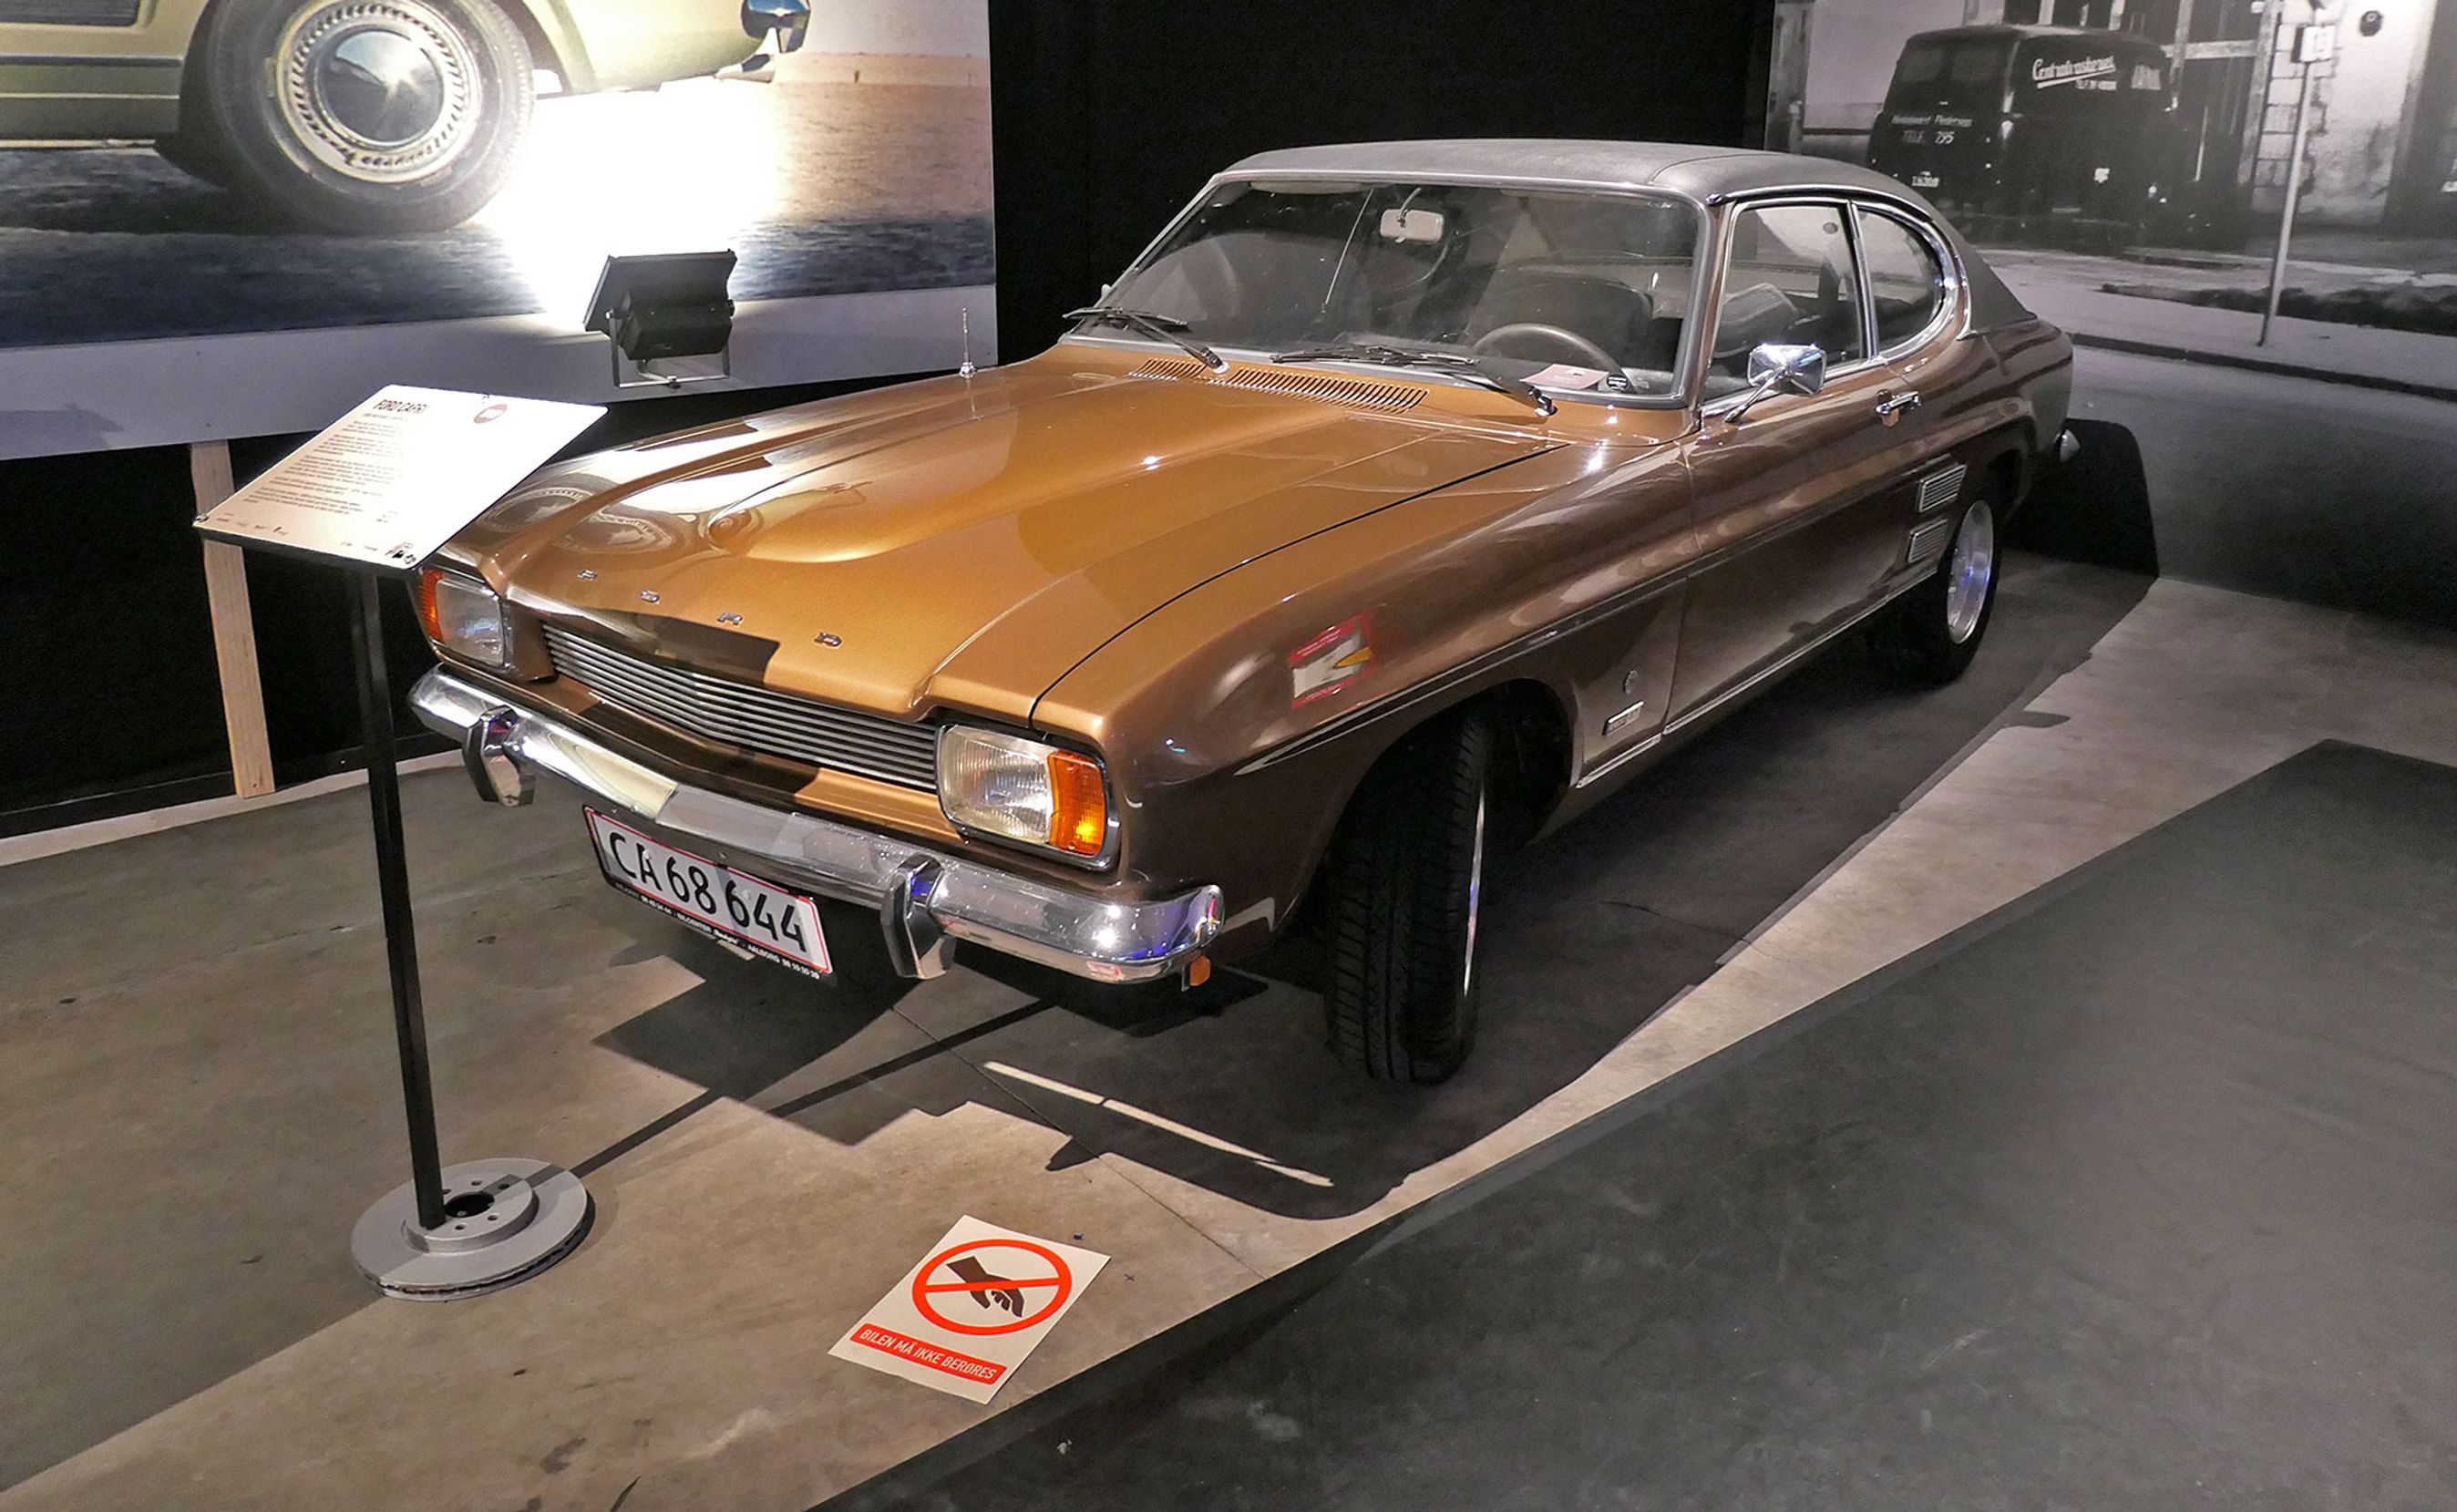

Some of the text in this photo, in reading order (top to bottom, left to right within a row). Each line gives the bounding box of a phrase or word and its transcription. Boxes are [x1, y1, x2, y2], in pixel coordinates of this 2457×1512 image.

[373, 398, 402, 412] FORD
[609, 831, 808, 953] CA 68 644
[859, 1329, 997, 1380] BILEN MÅ IKKE BERØRES
